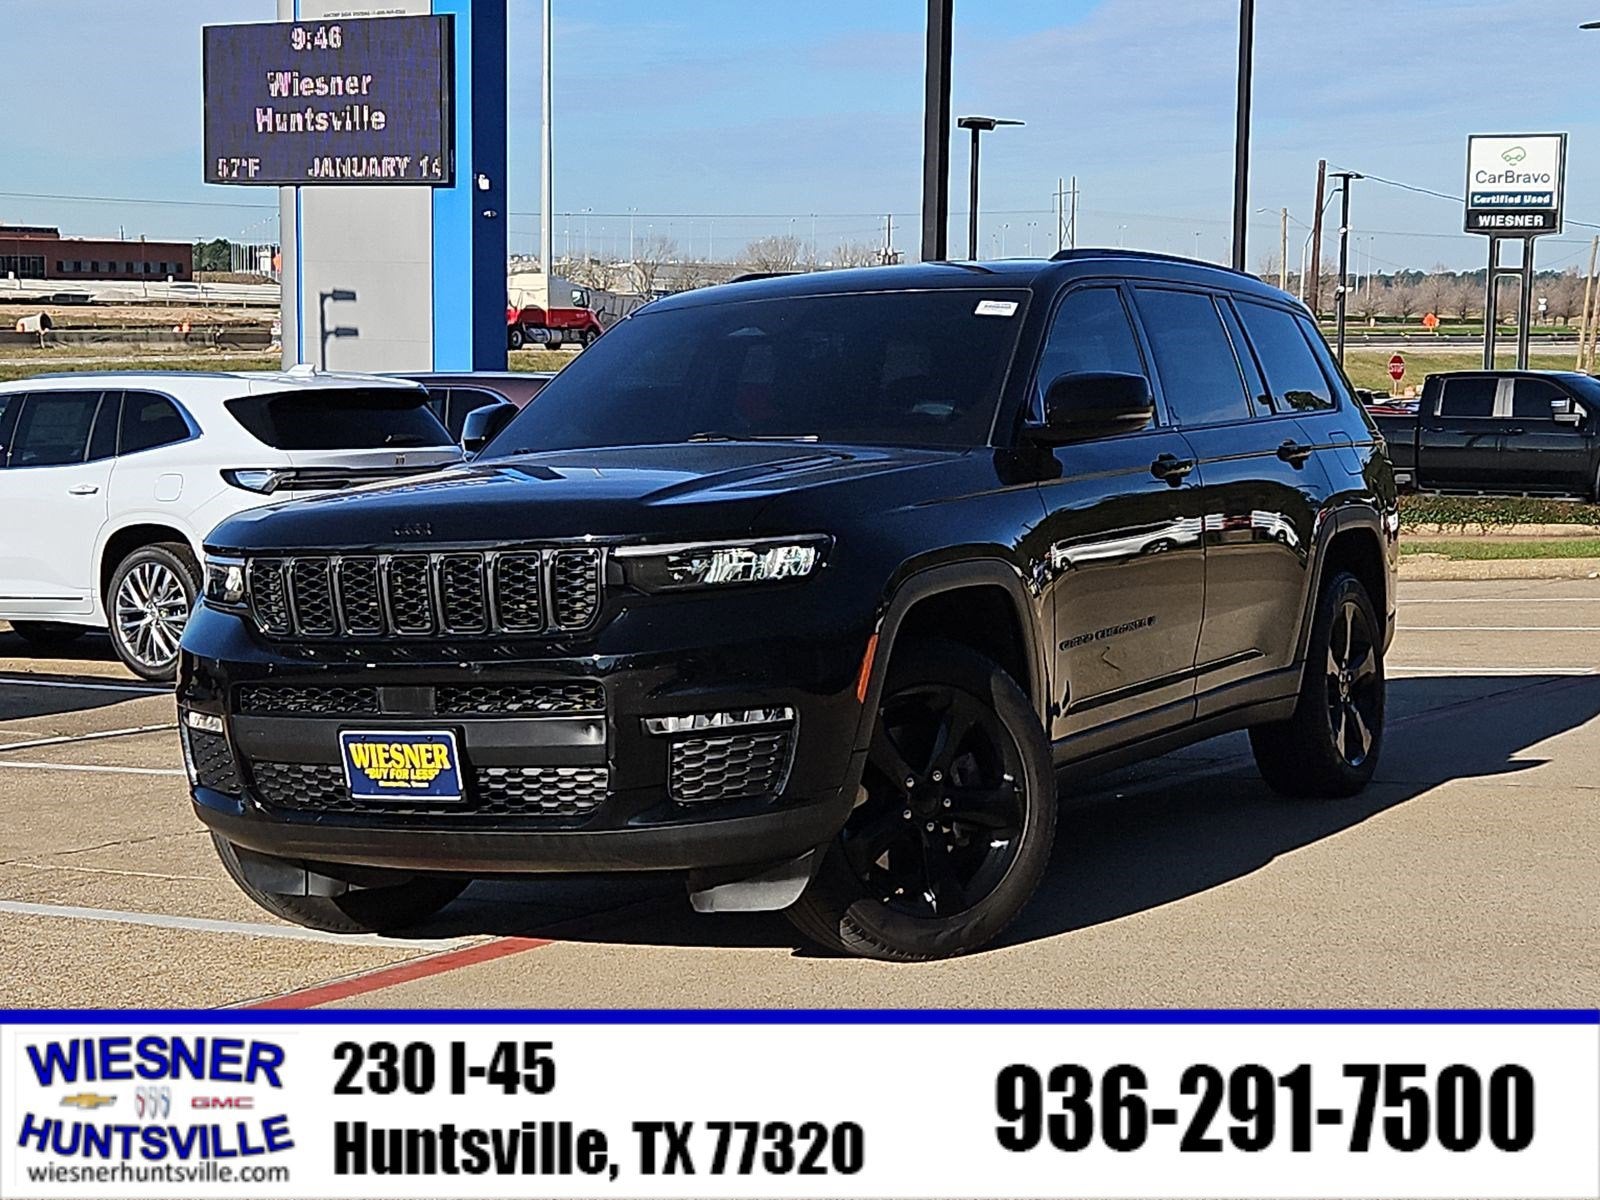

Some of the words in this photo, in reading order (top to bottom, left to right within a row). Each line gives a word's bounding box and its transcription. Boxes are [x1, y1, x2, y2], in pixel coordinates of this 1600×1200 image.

[291, 25, 342, 50] 9:46
[267, 71, 372, 98] Wiesner
[255, 104, 387, 133] Huntsville
[307, 156, 411, 178] JANUARY
[1475, 169, 1551, 184] CarBravo
[1473, 194, 1521, 204] Certified
[1523, 194, 1551, 204] Used
[1478, 214, 1544, 227] WIESNER
[348, 742, 451, 769] WIESNER
[389, 768, 409, 780] FOR
